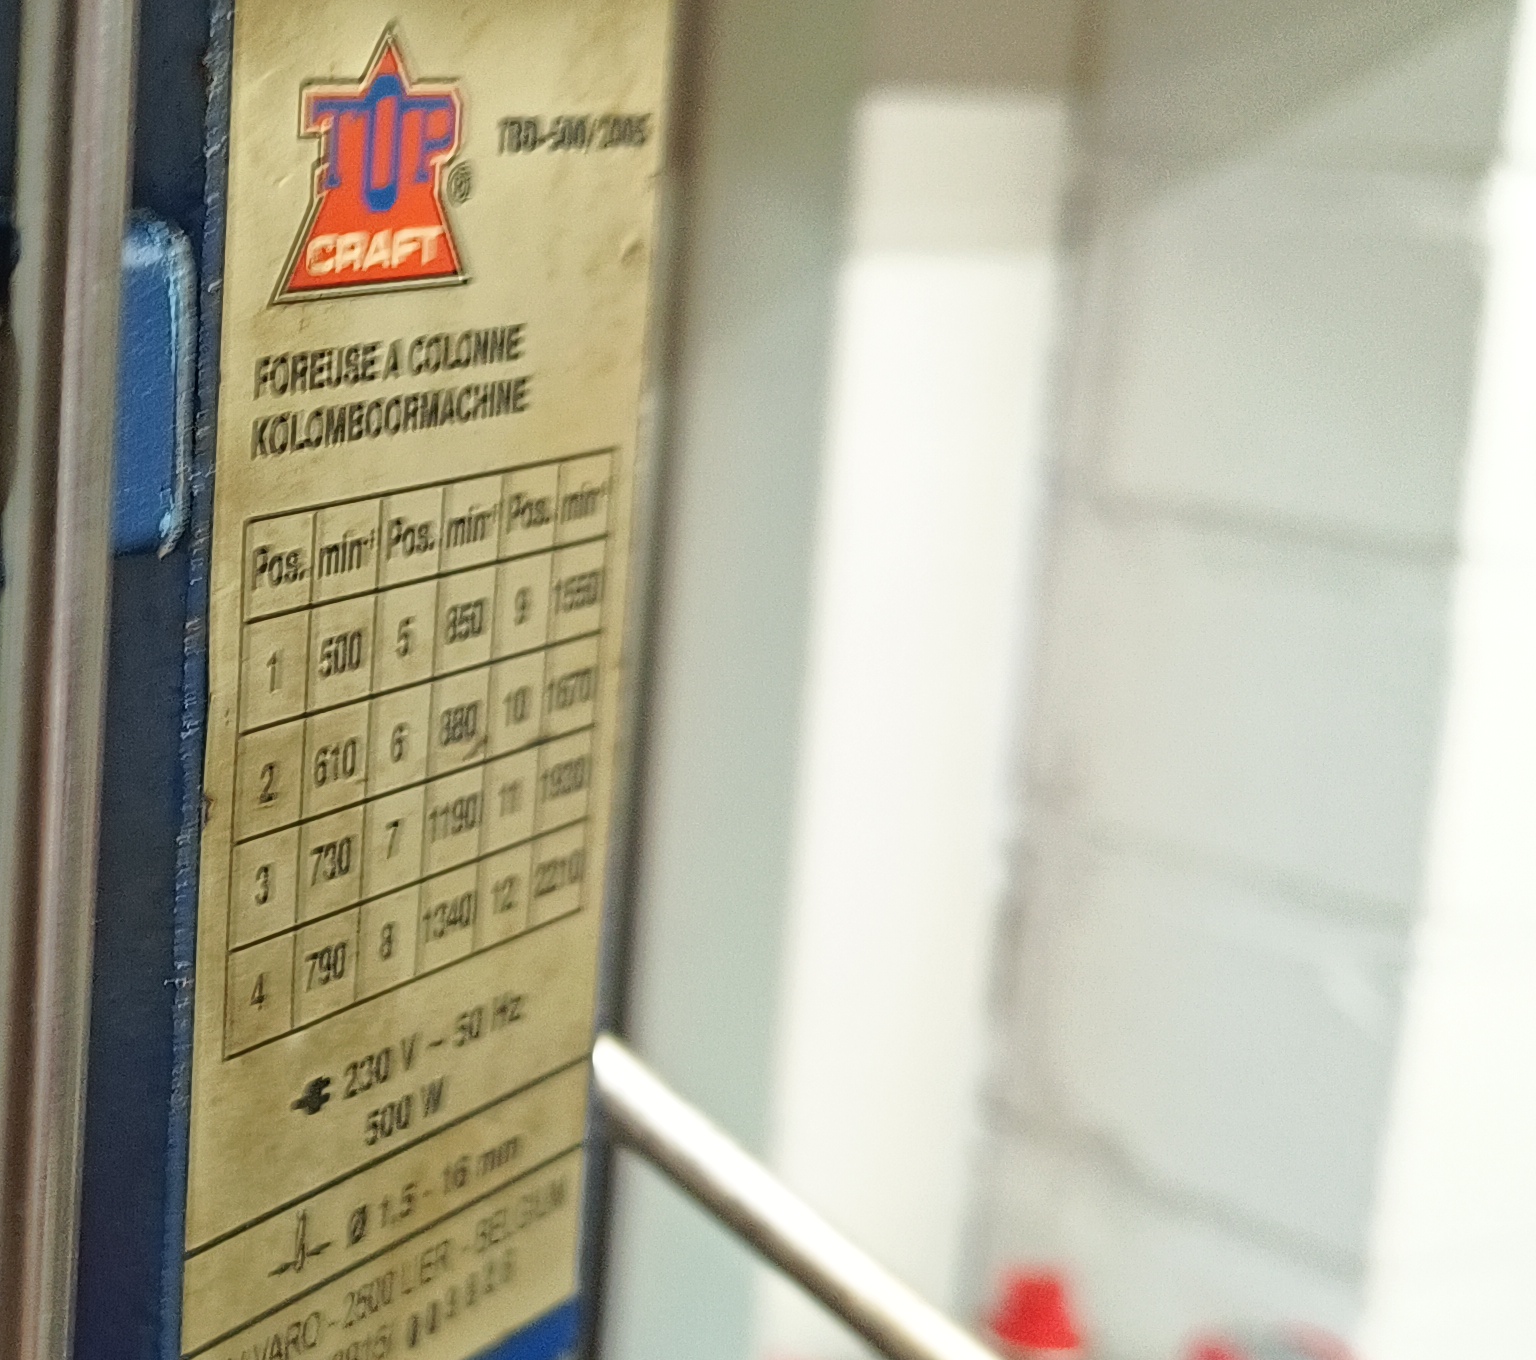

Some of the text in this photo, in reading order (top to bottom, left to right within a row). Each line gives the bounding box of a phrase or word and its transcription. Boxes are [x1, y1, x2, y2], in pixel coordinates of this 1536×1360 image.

[312, 74, 454, 212] TOP
[305, 225, 445, 276] CRAFT
[254, 323, 527, 399] FOREUSE A COLONNE
[250, 375, 532, 460] KOLOMBOORMACHINE
[252, 544, 311, 591] Pos.
[386, 516, 434, 560] Pos.
[265, 650, 278, 693] 1
[318, 629, 363, 678] 500
[396, 617, 415, 657] 5
[445, 597, 487, 644] 850
[259, 762, 278, 804] 2
[313, 738, 358, 787] 610
[390, 723, 409, 762] 6
[503, 686, 532, 725] 10
[254, 865, 271, 906] 3
[310, 835, 352, 886] 730
[386, 820, 402, 859] 7
[427, 792, 481, 842] 1190
[250, 973, 266, 1011] 4
[305, 941, 347, 992] 790
[379, 922, 396, 960] 8
[422, 889, 477, 941] 1340
[491, 875, 521, 915] 12
[343, 1046, 392, 1100] 230
[400, 1031, 418, 1071] V
[453, 1006, 484, 1047] 50
[490, 993, 525, 1032] Hz
[366, 1075, 445, 1146] 500 W
[443, 1154, 470, 1196] 16
